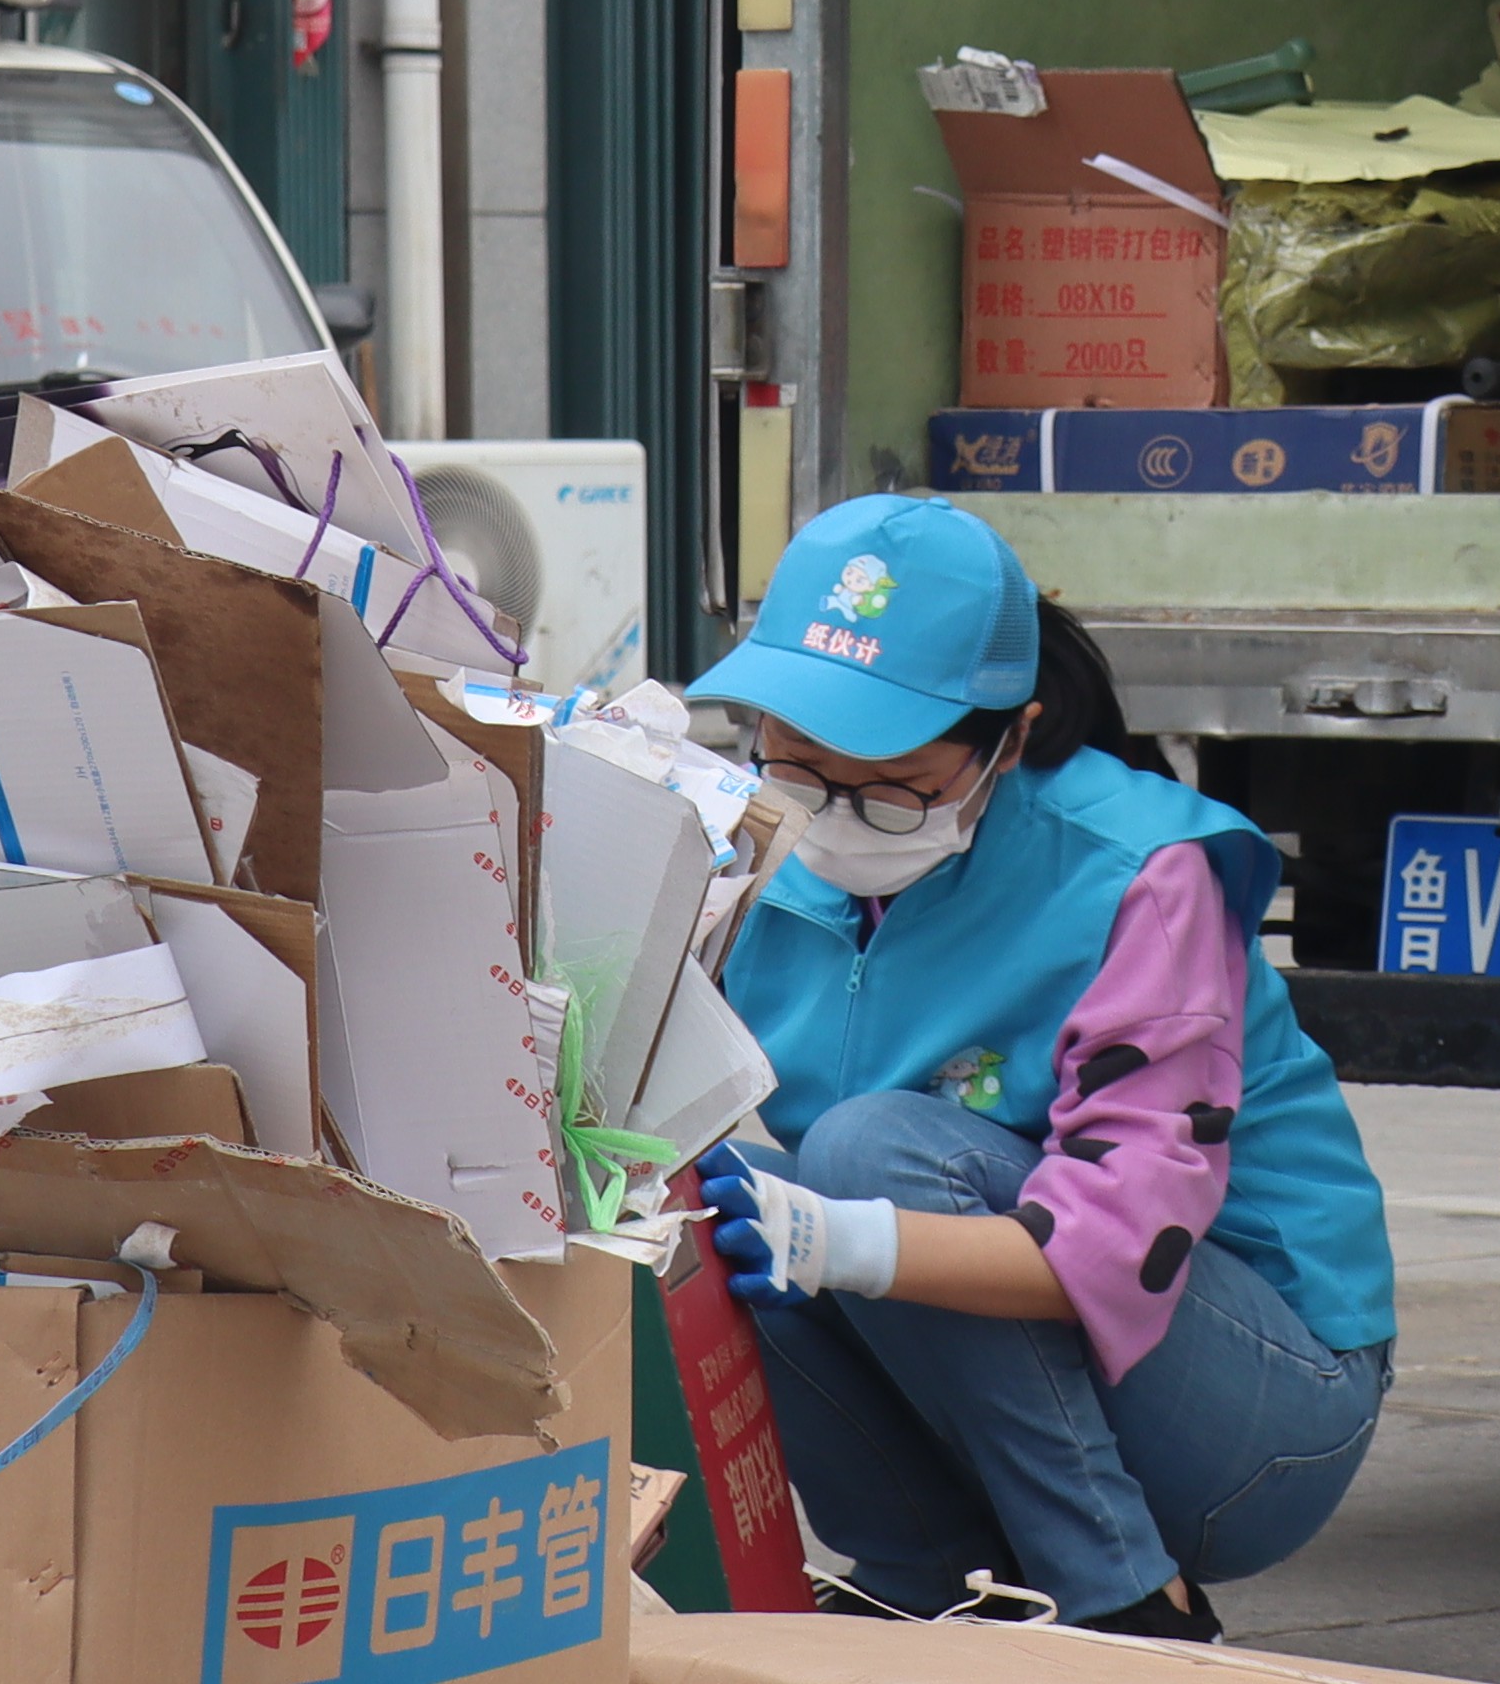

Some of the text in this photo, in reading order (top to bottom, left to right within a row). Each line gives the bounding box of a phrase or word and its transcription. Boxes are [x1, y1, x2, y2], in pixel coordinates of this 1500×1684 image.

[803, 621, 883, 666] 纸伙计
[369, 1473, 601, 1655] 日丰管
